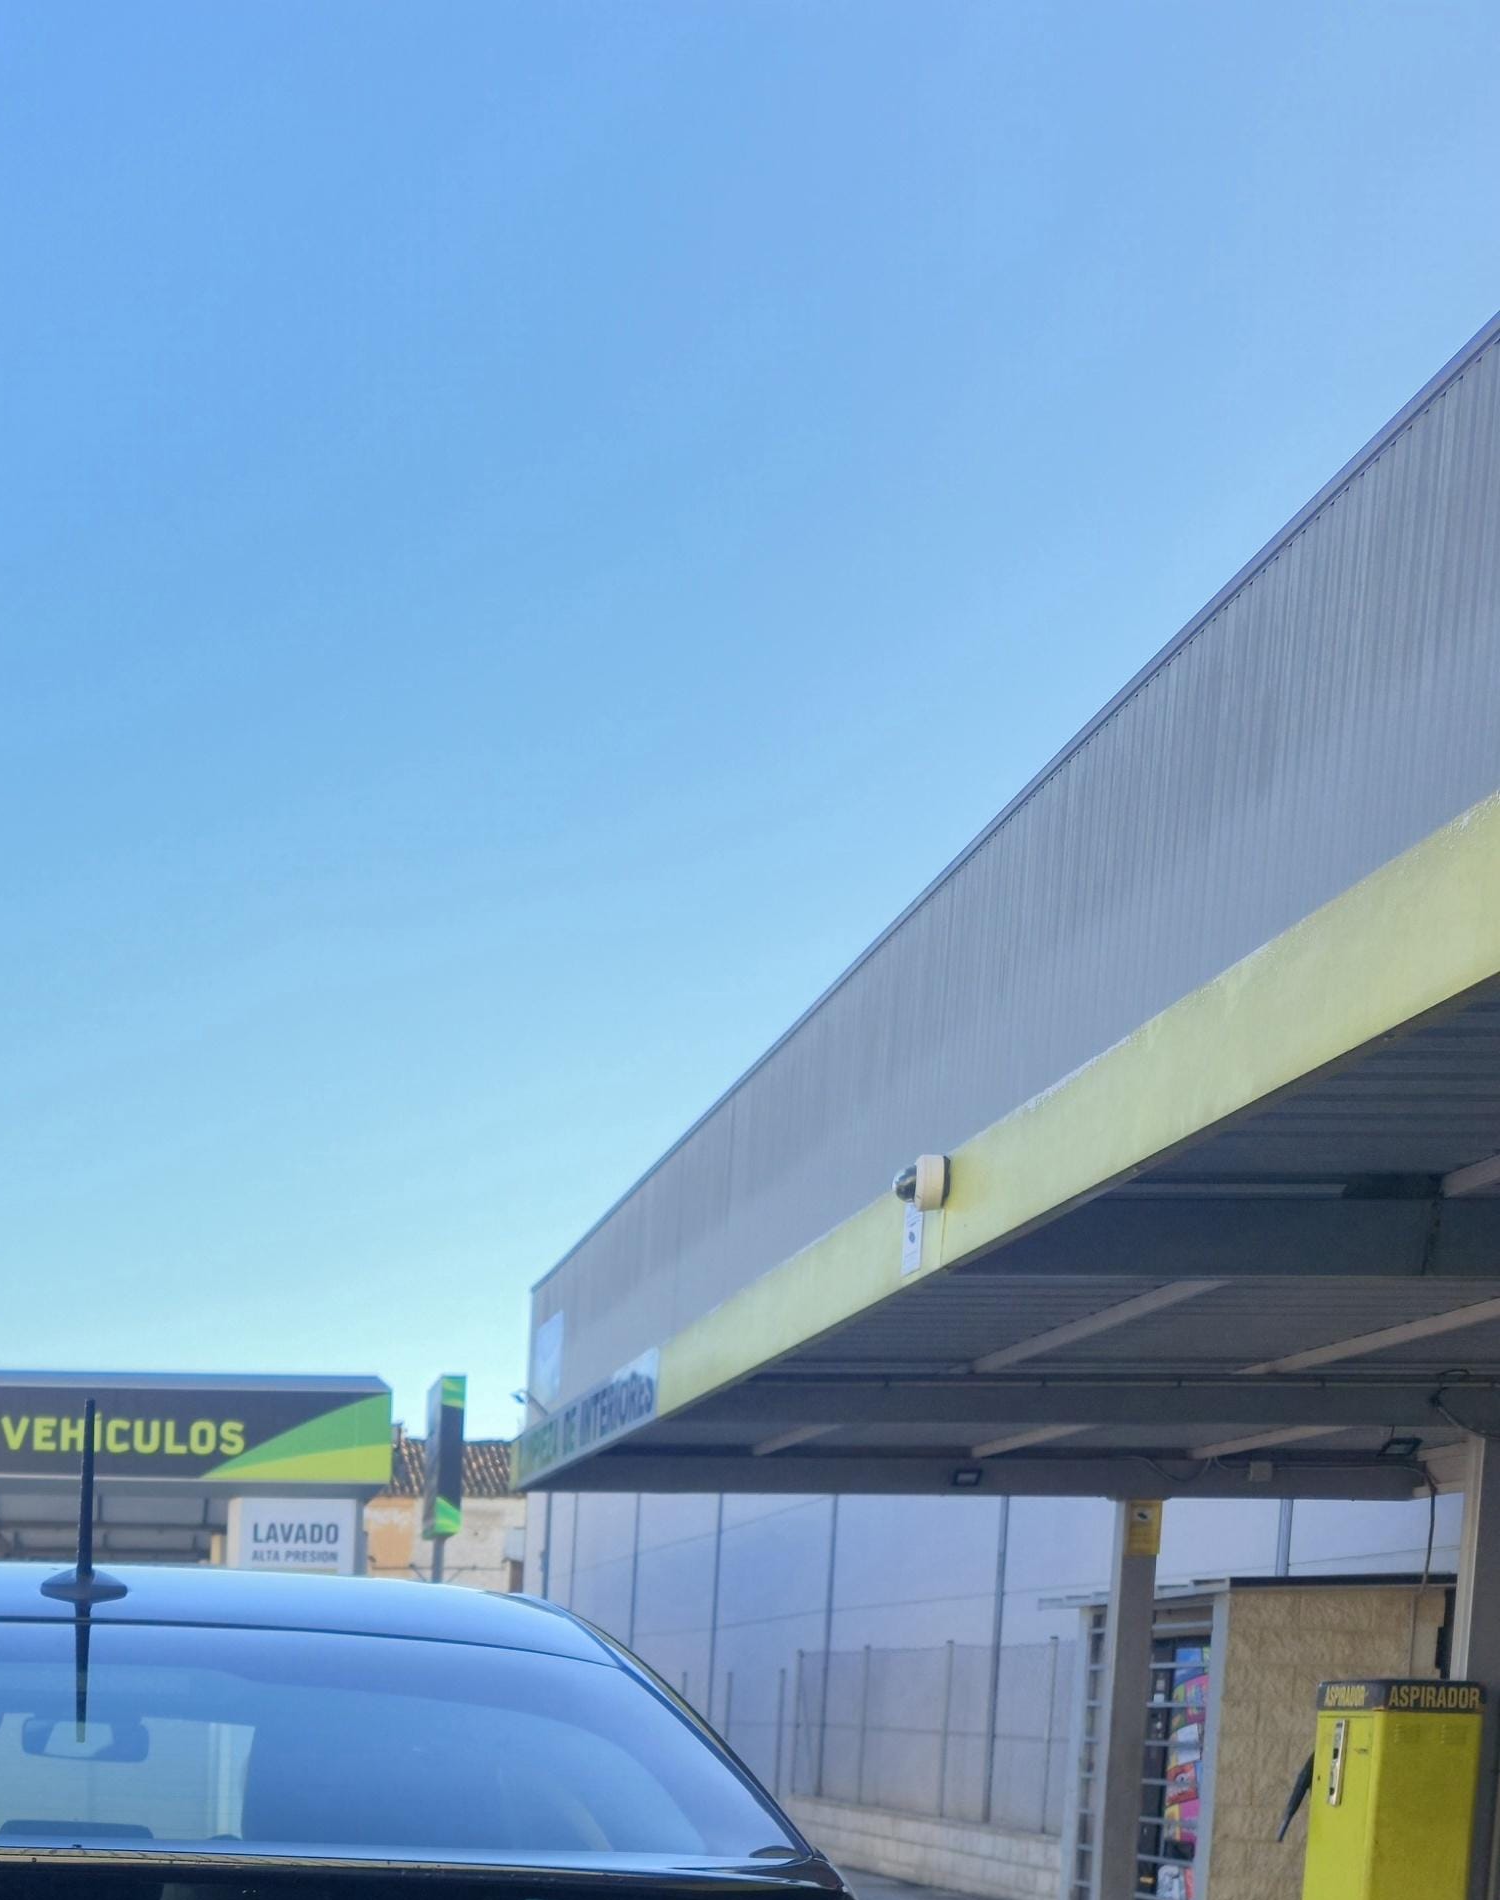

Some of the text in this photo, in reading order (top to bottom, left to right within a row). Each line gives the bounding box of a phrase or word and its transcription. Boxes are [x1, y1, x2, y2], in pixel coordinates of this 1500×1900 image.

[252, 1522, 339, 1545] LAVADO
[252, 1550, 280, 1562] ALTA
[1324, 1685, 1366, 1707] ASPIRADOR
[1388, 1685, 1481, 1709] ASPIRADOR
